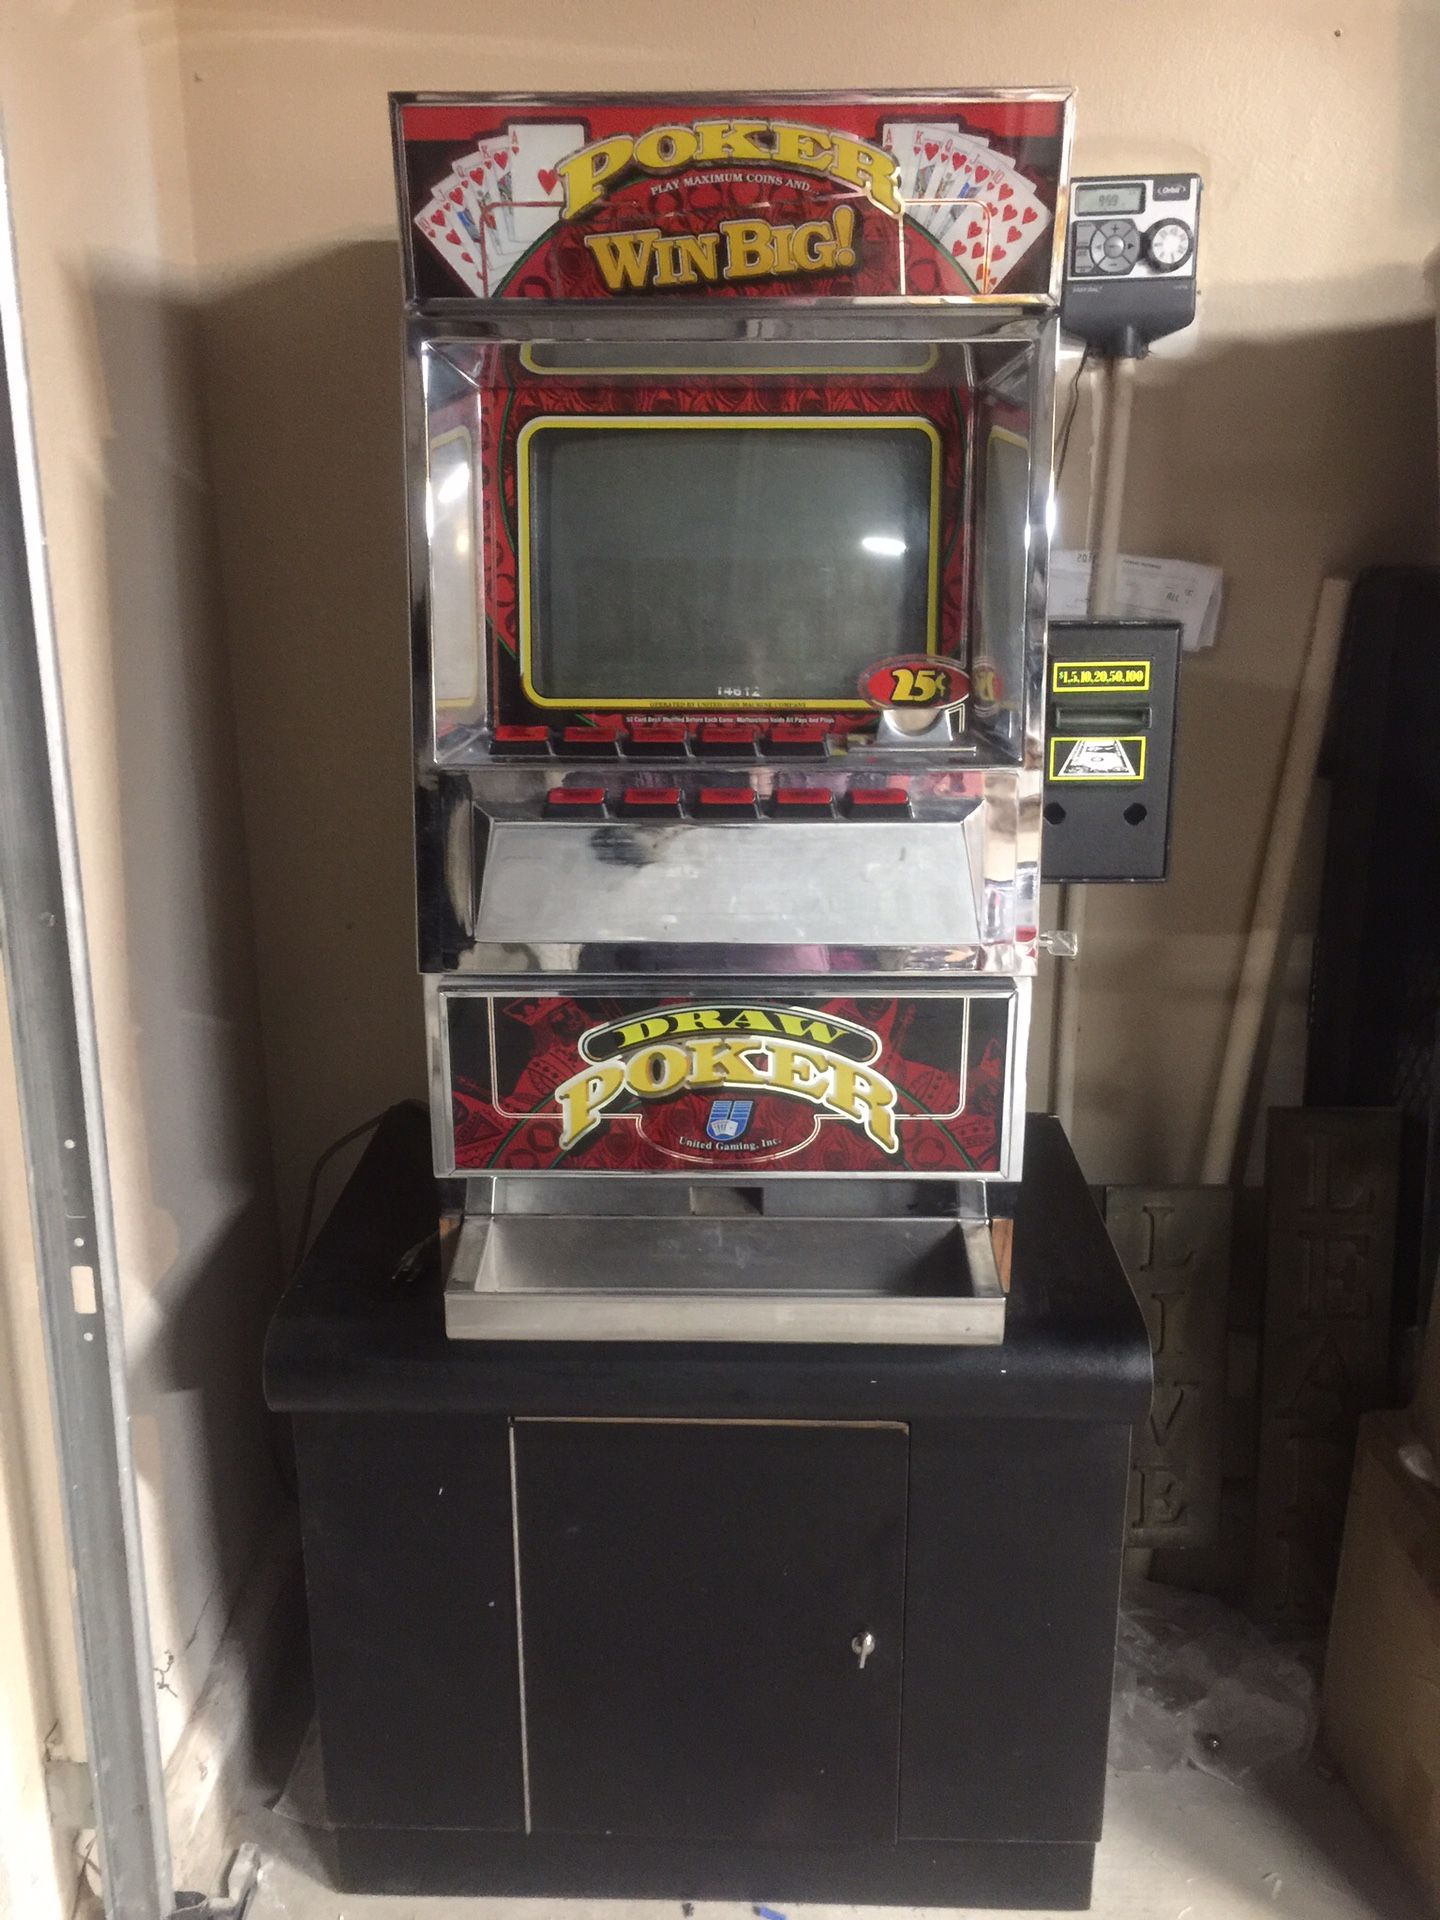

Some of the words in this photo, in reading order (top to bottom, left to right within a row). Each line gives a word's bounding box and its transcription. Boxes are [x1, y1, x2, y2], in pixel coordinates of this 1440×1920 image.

[559, 120, 902, 219] POKER
[650, 178, 680, 196] PLAY
[684, 173, 743, 187] MAXIMUM
[746, 173, 783, 186] COINS
[584, 226, 719, 291] WIN
[719, 204, 858, 280] BIG!
[891, 668, 946, 702] 25¢
[616, 1008, 850, 1049] DRAW
[555, 1037, 900, 1154] POKER
[679, 1136, 712, 1150] United
[762, 1138, 781, 1148] Inc.
